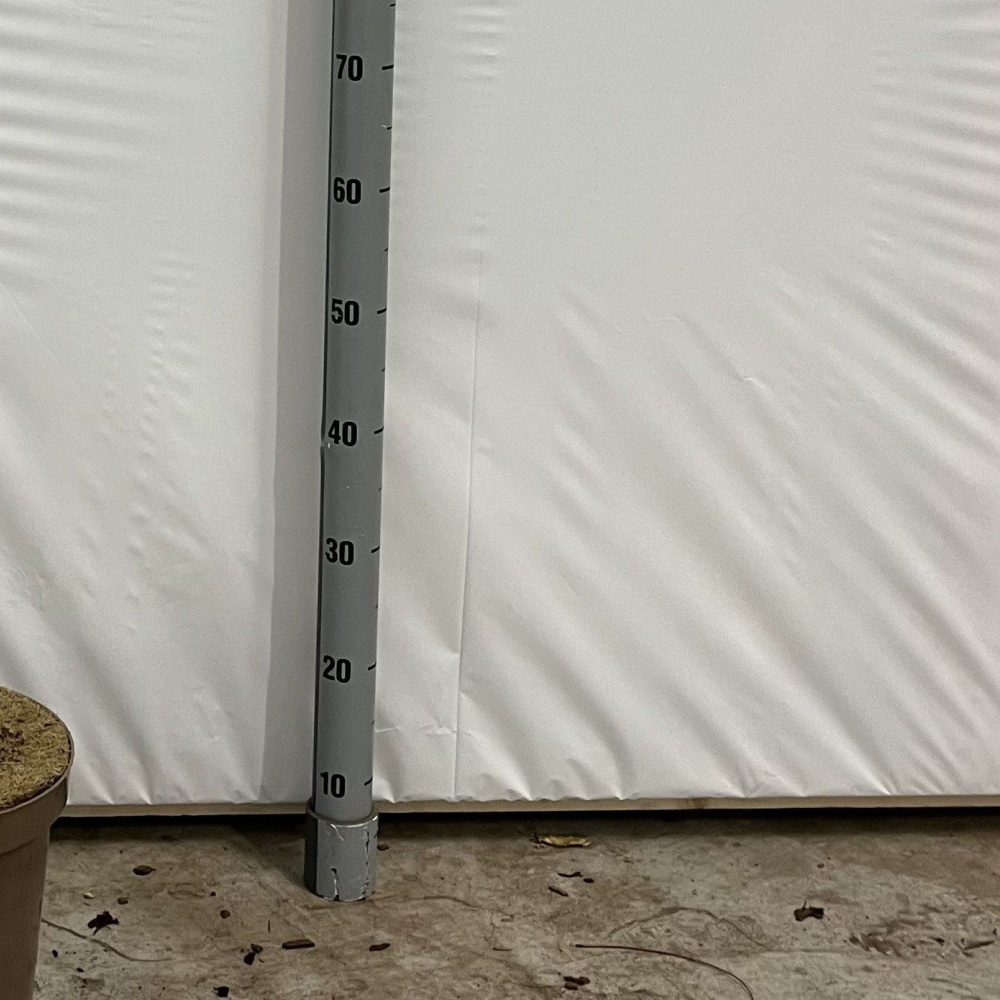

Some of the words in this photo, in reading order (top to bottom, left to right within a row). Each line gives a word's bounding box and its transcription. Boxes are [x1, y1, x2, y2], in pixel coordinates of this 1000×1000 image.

[336, 53, 363, 82] 70
[333, 176, 362, 205] 60
[331, 297, 360, 327] 50
[327, 419, 358, 447] 40
[324, 537, 355, 566] 30
[322, 654, 352, 684] 20
[320, 771, 346, 799] 10
